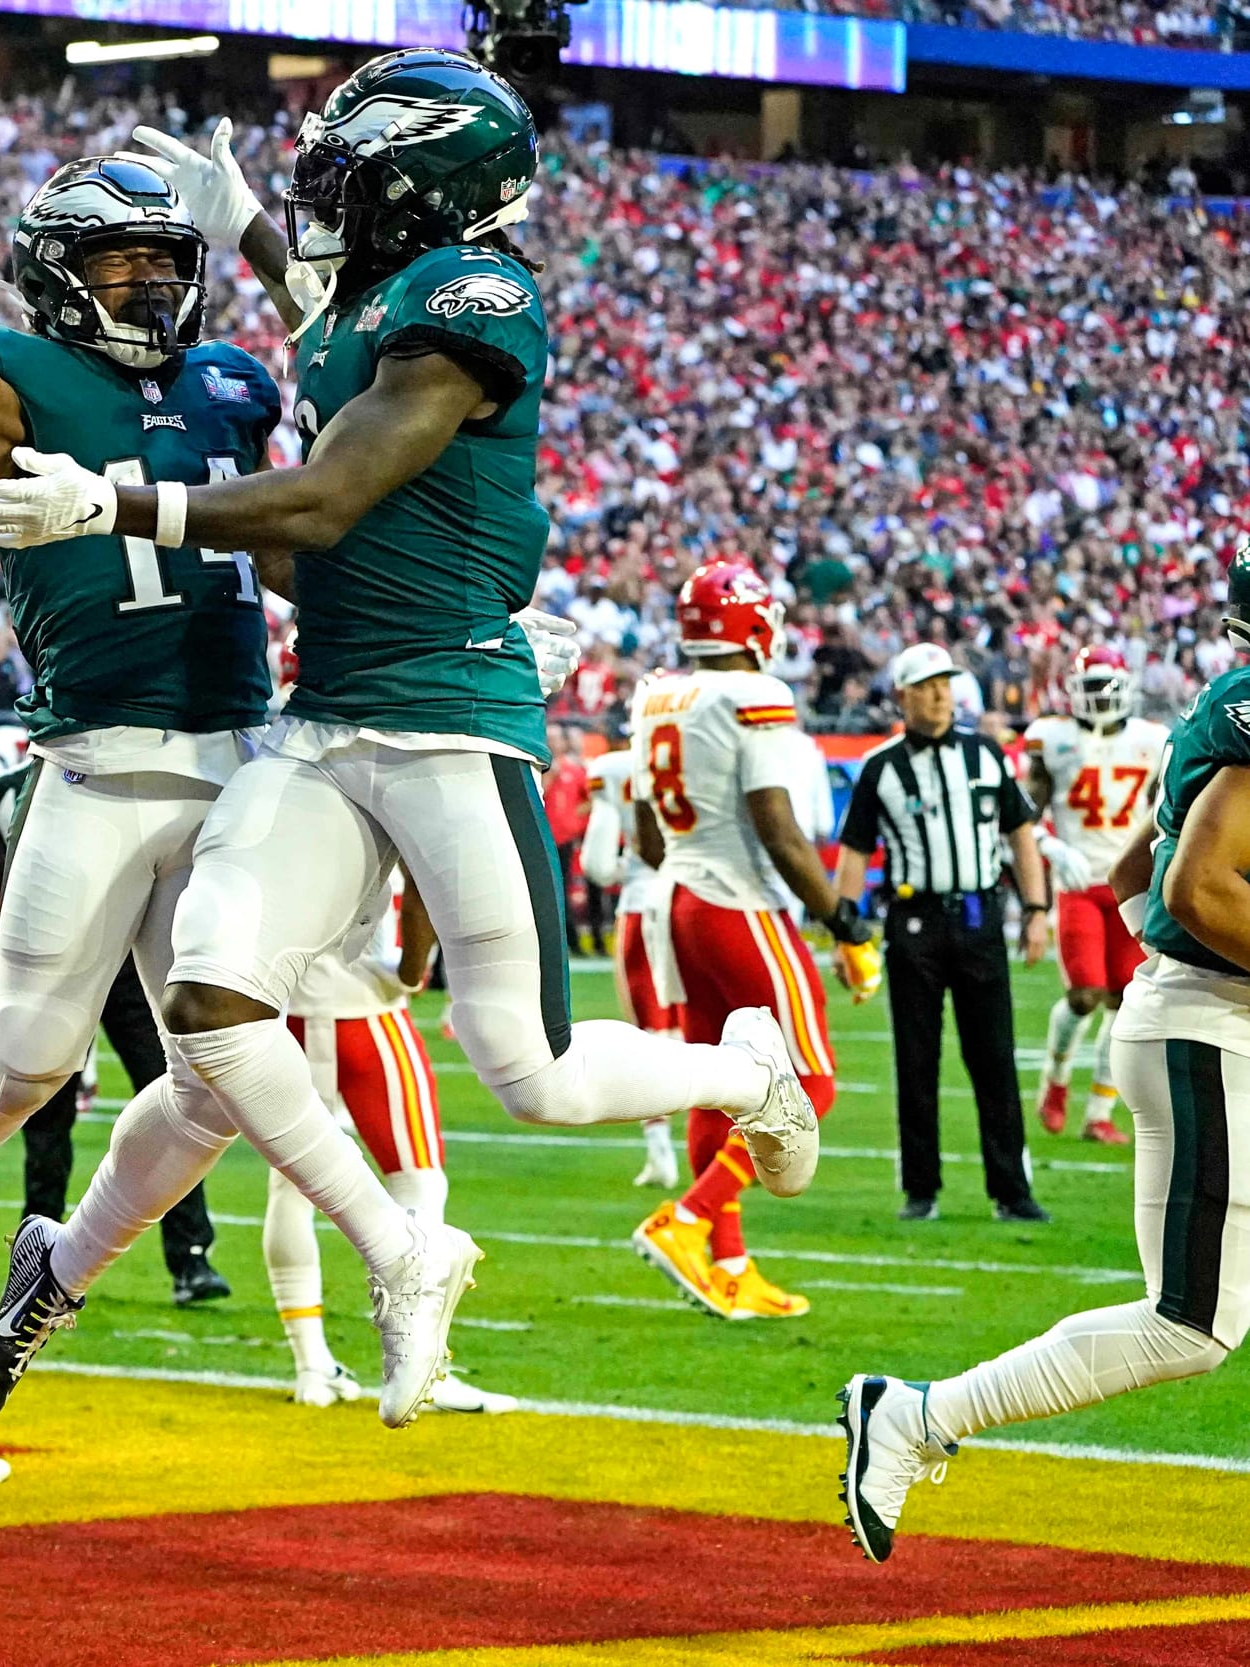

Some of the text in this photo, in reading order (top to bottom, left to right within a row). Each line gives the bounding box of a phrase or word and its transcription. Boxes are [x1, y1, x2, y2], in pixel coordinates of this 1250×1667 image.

[140, 414, 188, 432] EAGLES
[103, 456, 260, 612] 14
[648, 722, 698, 835] 8
[1066, 765, 1149, 828] 47
